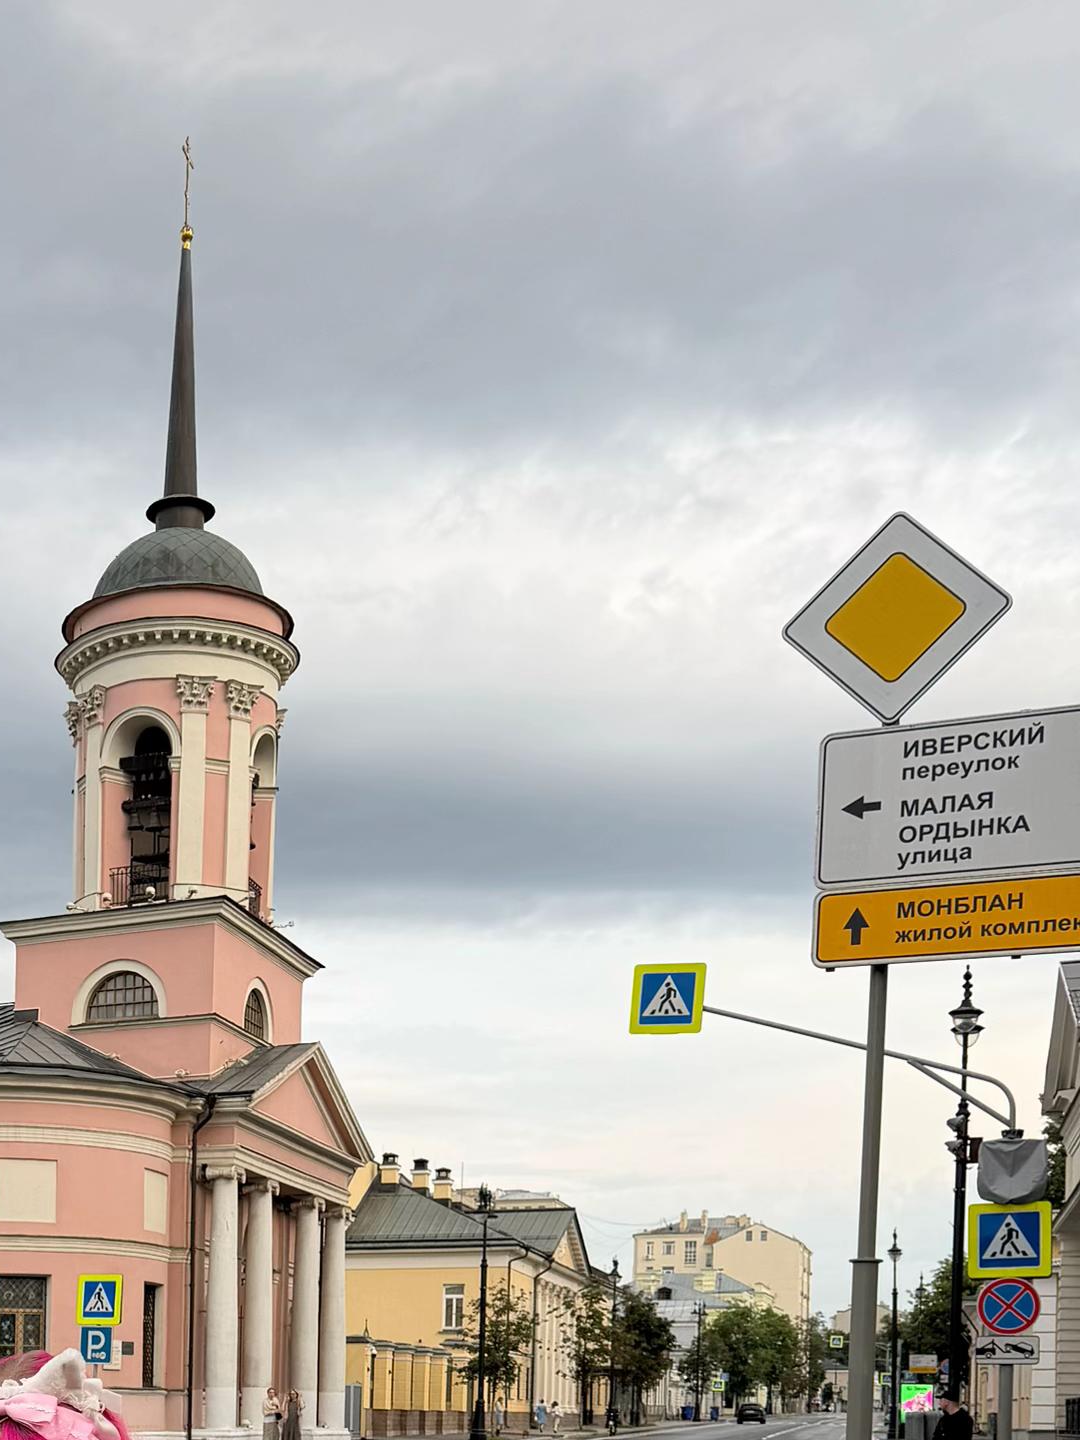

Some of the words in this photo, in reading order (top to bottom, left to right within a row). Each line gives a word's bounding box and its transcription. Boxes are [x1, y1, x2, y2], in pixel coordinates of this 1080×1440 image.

[903, 721, 1045, 759] ИВЕРСКИЙ
[901, 755, 1020, 781] переулок
[900, 791, 993, 817] МАЛАЯ
[899, 814, 1031, 844] ОРДЫНКА
[897, 846, 972, 870] улица
[896, 892, 1024, 919] МОНБЛАН
[895, 921, 972, 943] жилой
